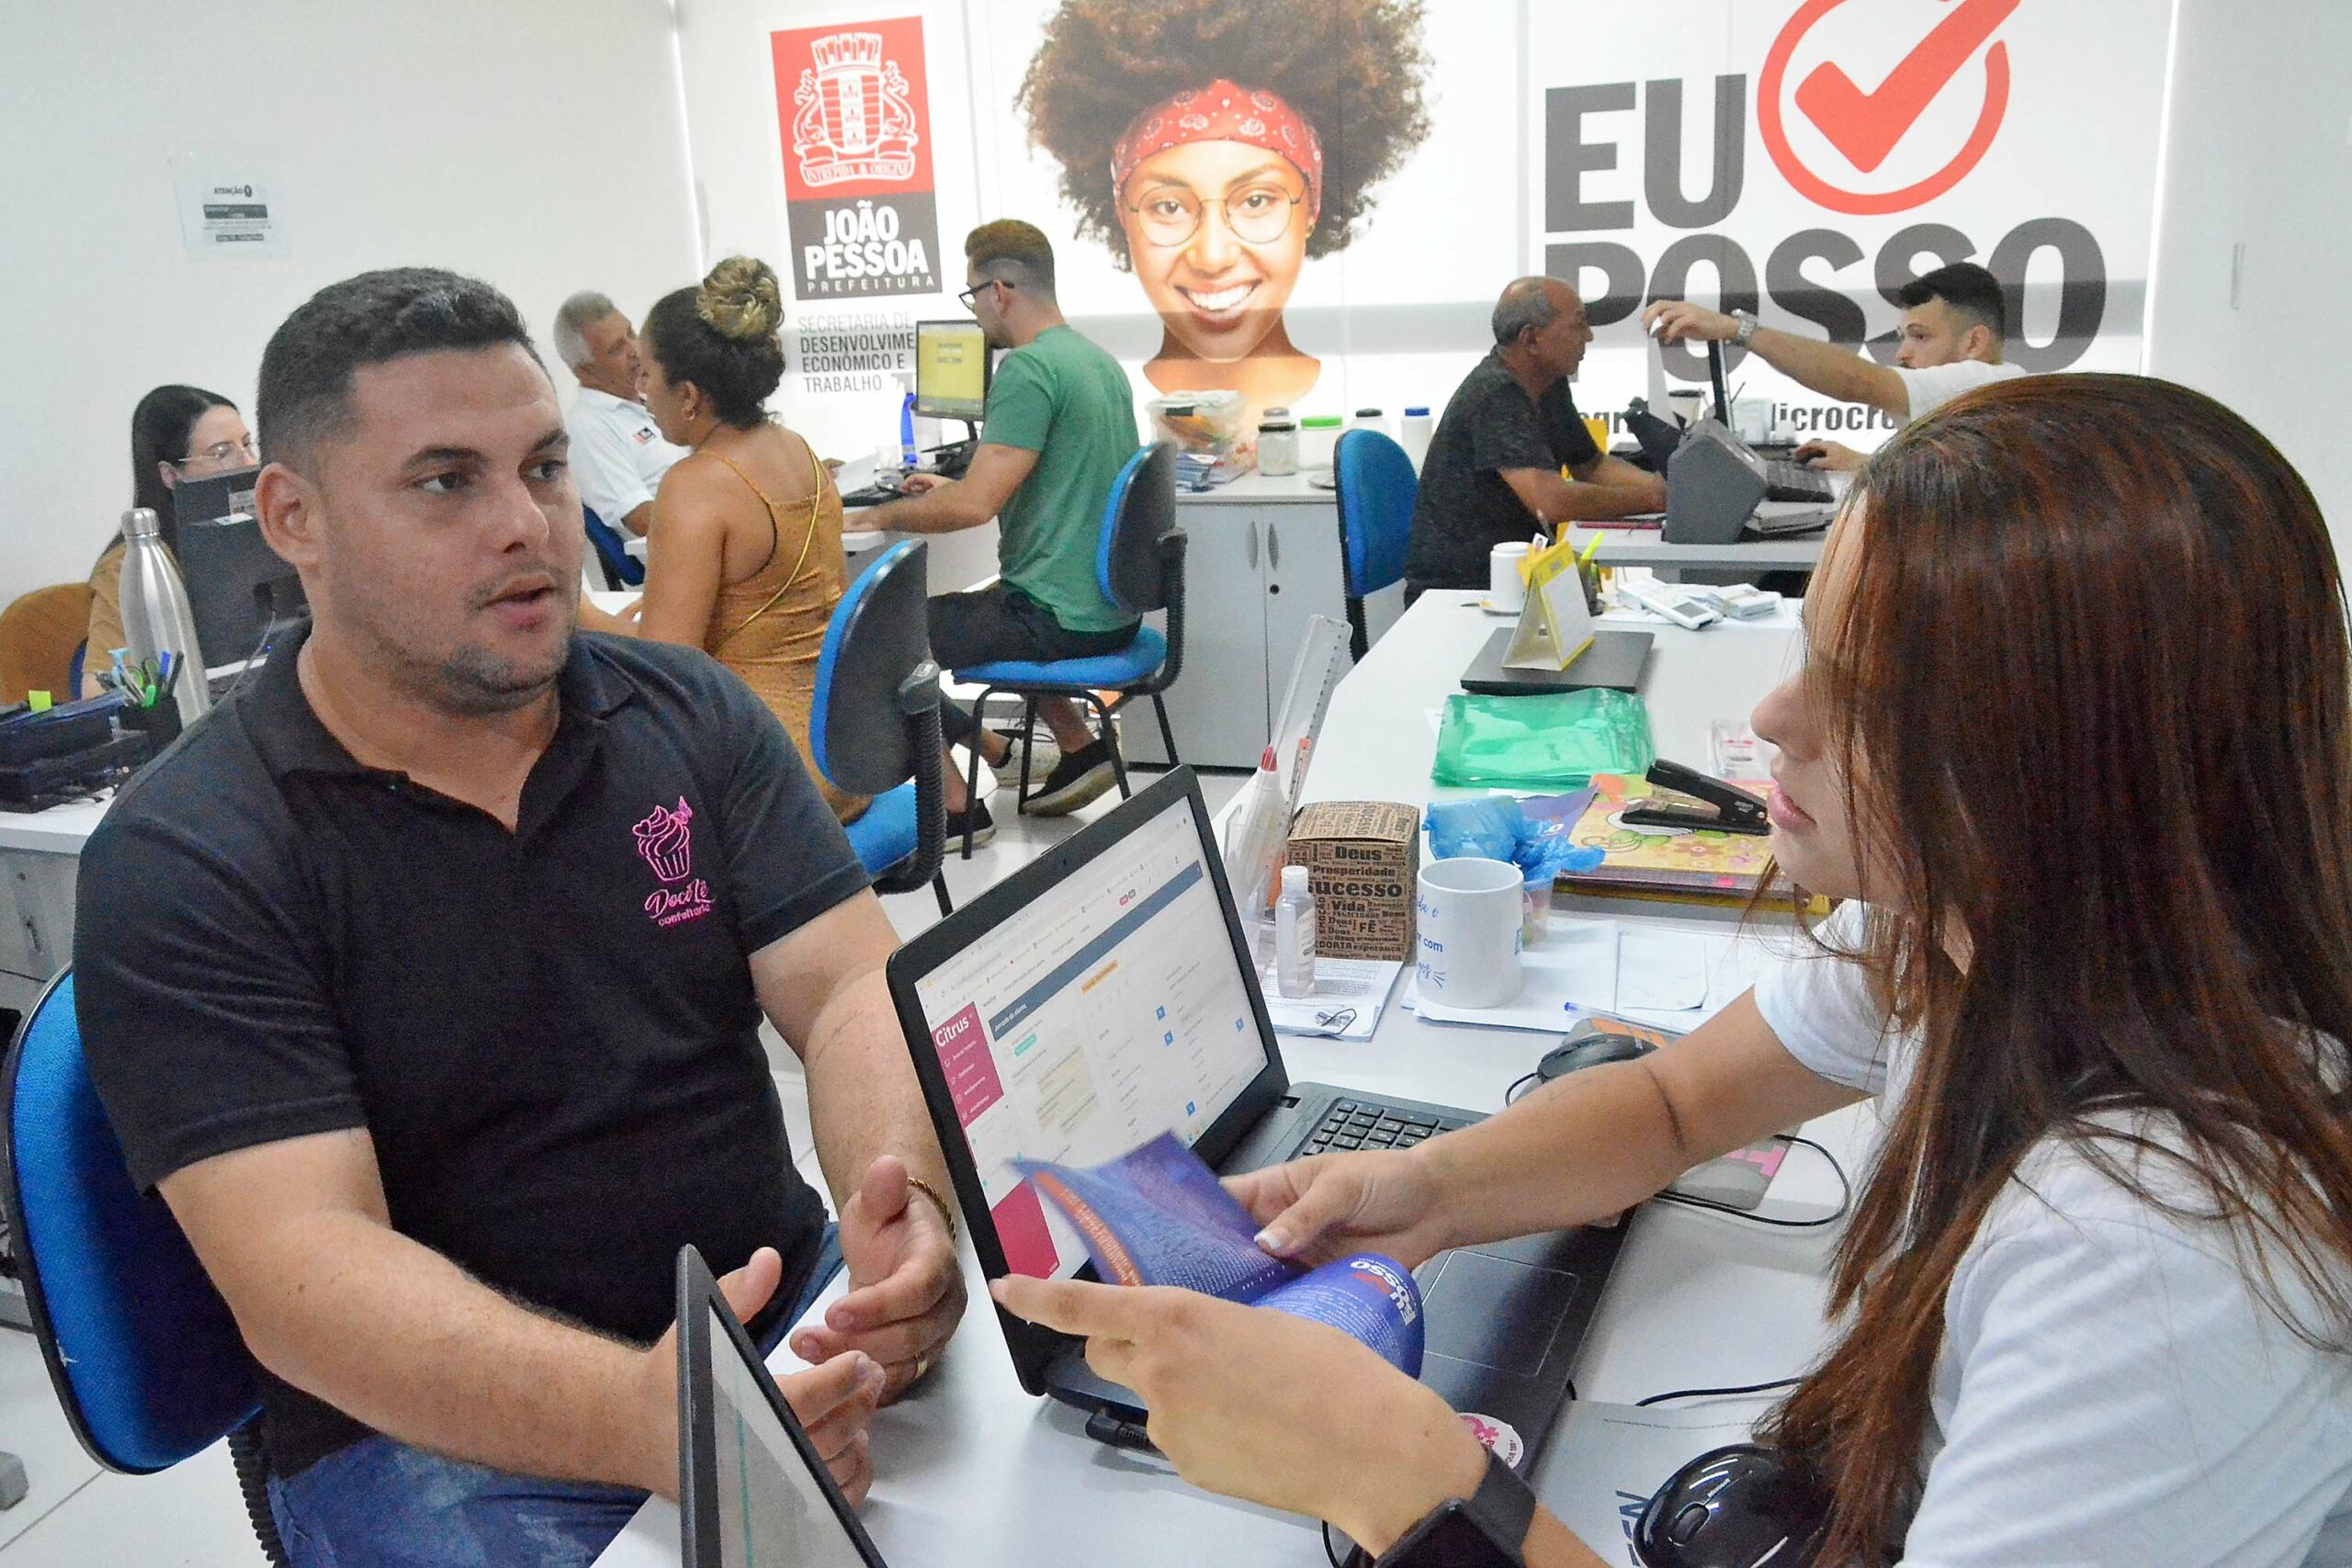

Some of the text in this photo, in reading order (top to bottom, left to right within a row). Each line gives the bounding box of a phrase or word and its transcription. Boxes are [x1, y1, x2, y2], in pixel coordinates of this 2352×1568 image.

[1544, 73, 1747, 232] EU
[823, 199, 899, 245] JOÃO
[804, 239, 930, 279] PESSOA
[808, 275, 935, 293] PREFEITURA
[798, 310, 914, 333] SECRETARIA DE
[802, 351, 905, 373] ECONÔMICO E
[804, 374, 882, 393] TRABALHO
[1335, 845, 1382, 861] Deus
[1313, 864, 1396, 877] Prosperidade
[1331, 901, 1366, 911] Vida
[1423, 937, 1443, 953] com
[935, 1016, 969, 1047] Citrus
